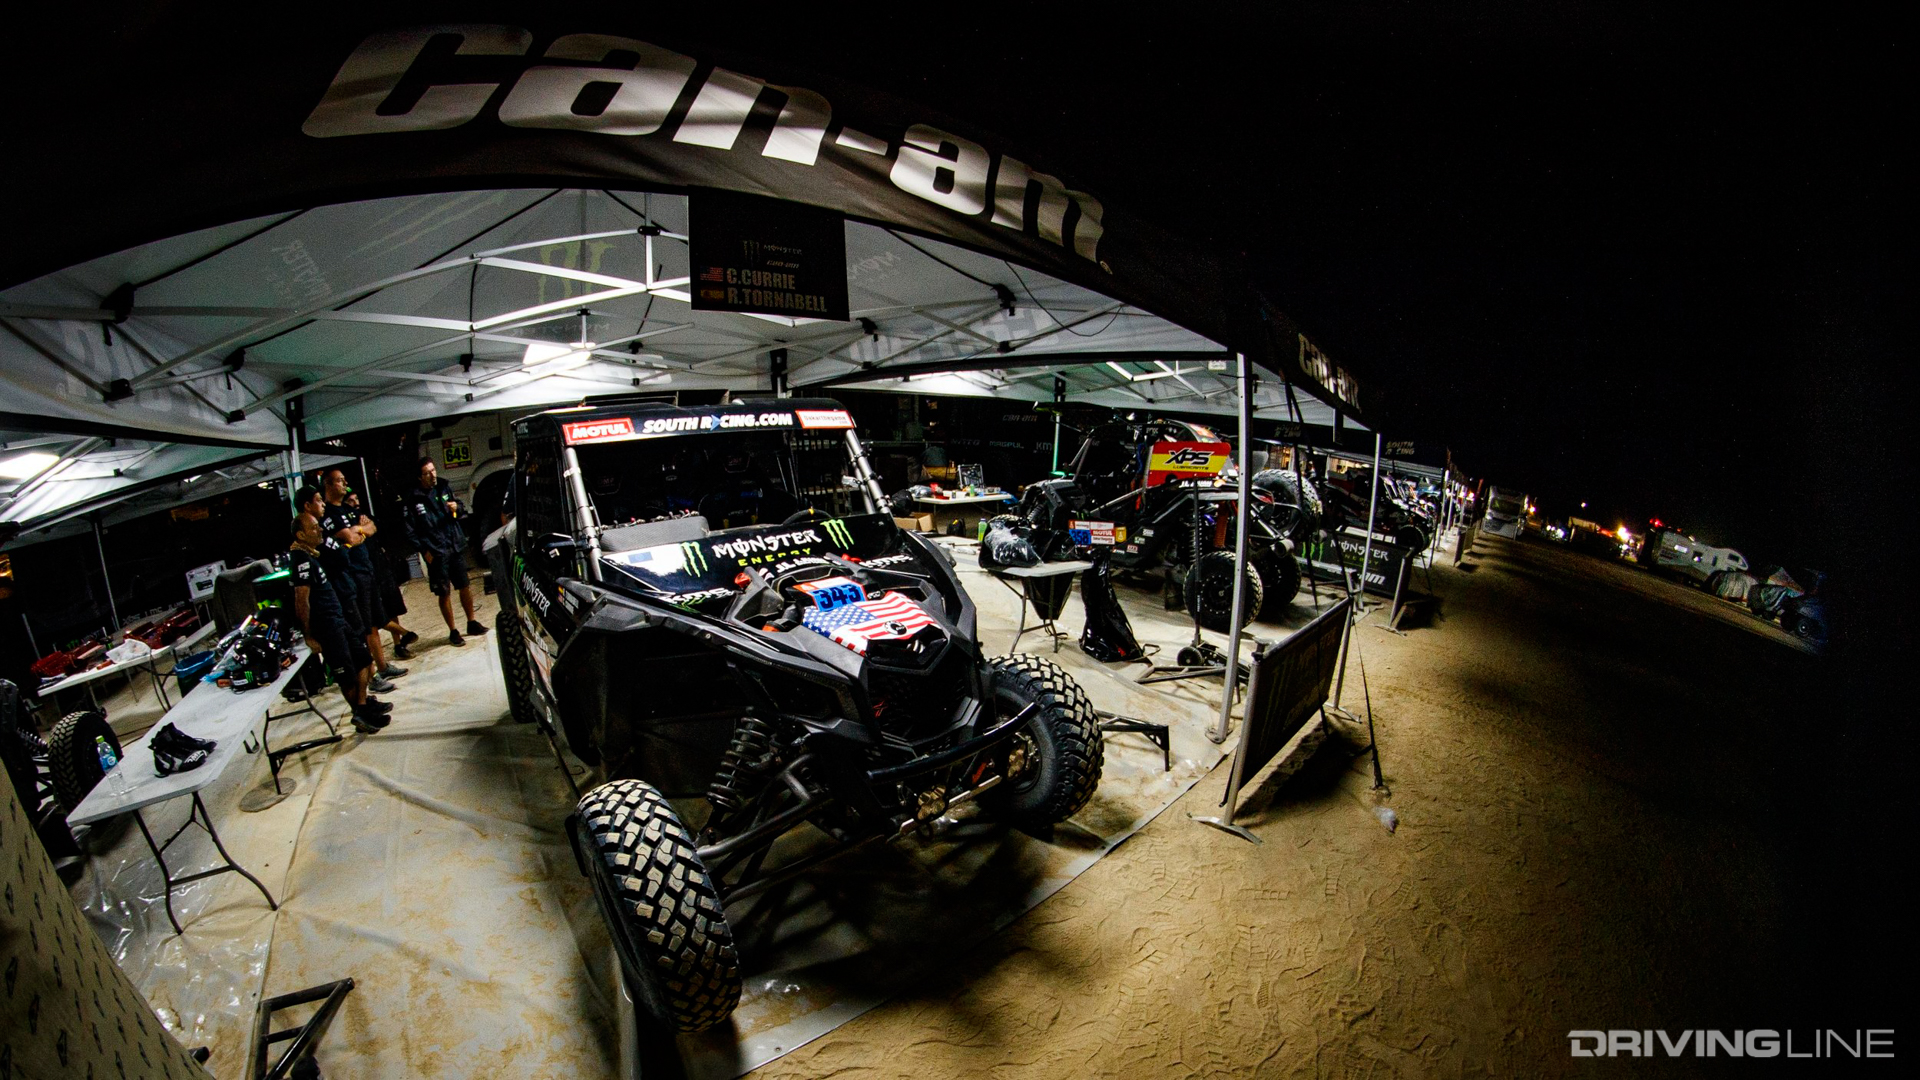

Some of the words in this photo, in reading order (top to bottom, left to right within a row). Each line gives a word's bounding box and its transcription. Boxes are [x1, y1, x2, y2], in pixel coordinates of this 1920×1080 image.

[726, 267, 796, 290] C.CURRIE
[727, 287, 828, 312] R.TORNABELL
[572, 424, 628, 439] MOTUL
[643, 417, 699, 434] SOUTH
[446, 447, 469, 462] 649
[1164, 447, 1214, 465] XPS
[712, 529, 822, 559] MONSTER
[1330, 539, 1389, 562] MONSER
[522, 571, 551, 618] MONSTER
[813, 584, 862, 610] 343
